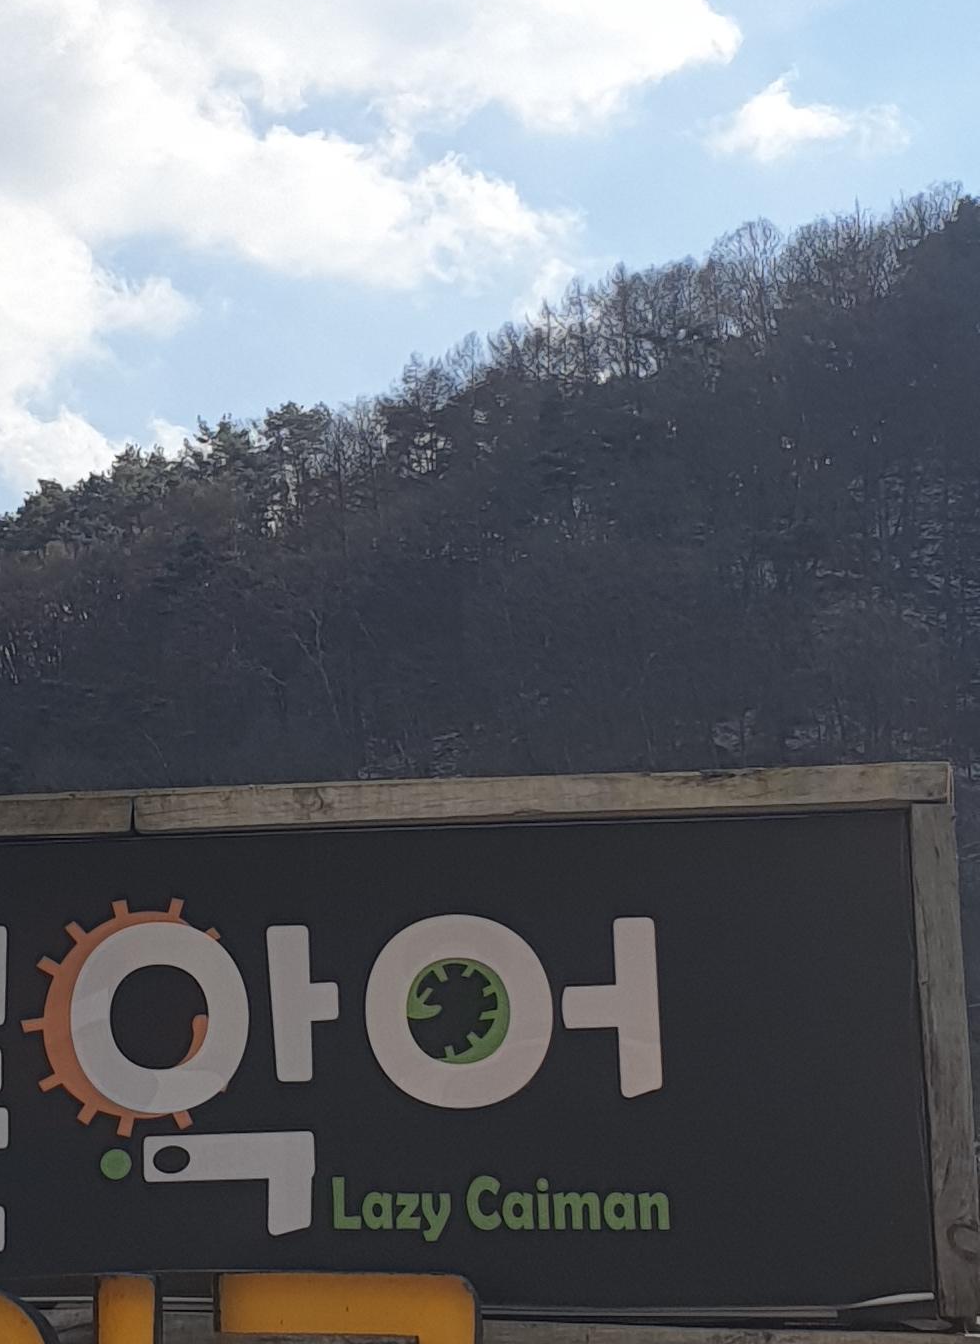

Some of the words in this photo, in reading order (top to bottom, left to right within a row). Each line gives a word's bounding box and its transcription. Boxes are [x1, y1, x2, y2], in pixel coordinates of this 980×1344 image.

[23, 912, 663, 1236] 악어
[332, 1176, 452, 1242] Lazy
[465, 1175, 671, 1233] Caiman
